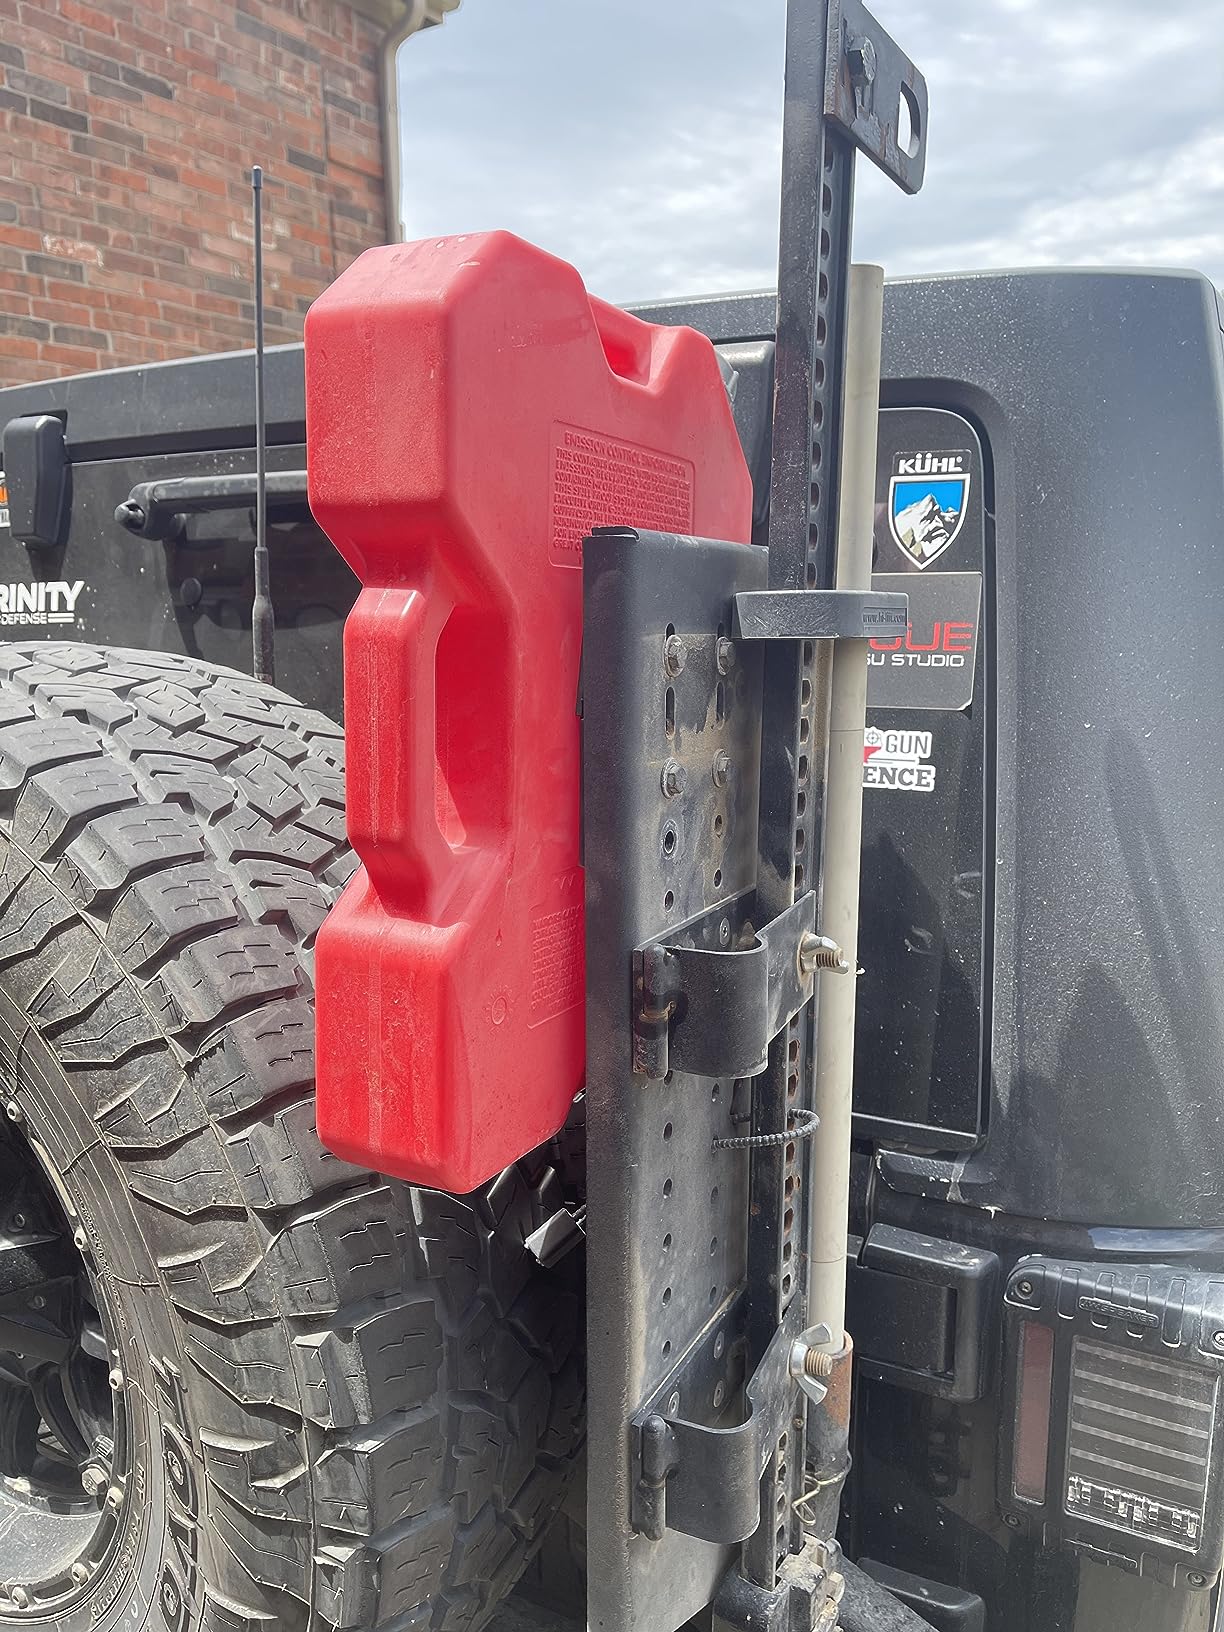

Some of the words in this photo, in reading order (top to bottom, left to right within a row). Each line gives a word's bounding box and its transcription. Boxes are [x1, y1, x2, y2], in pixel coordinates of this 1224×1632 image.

[899, 453, 963, 474] KÜHL
[891, 653, 965, 667] STUDIO
[886, 734, 928, 755] GUN
